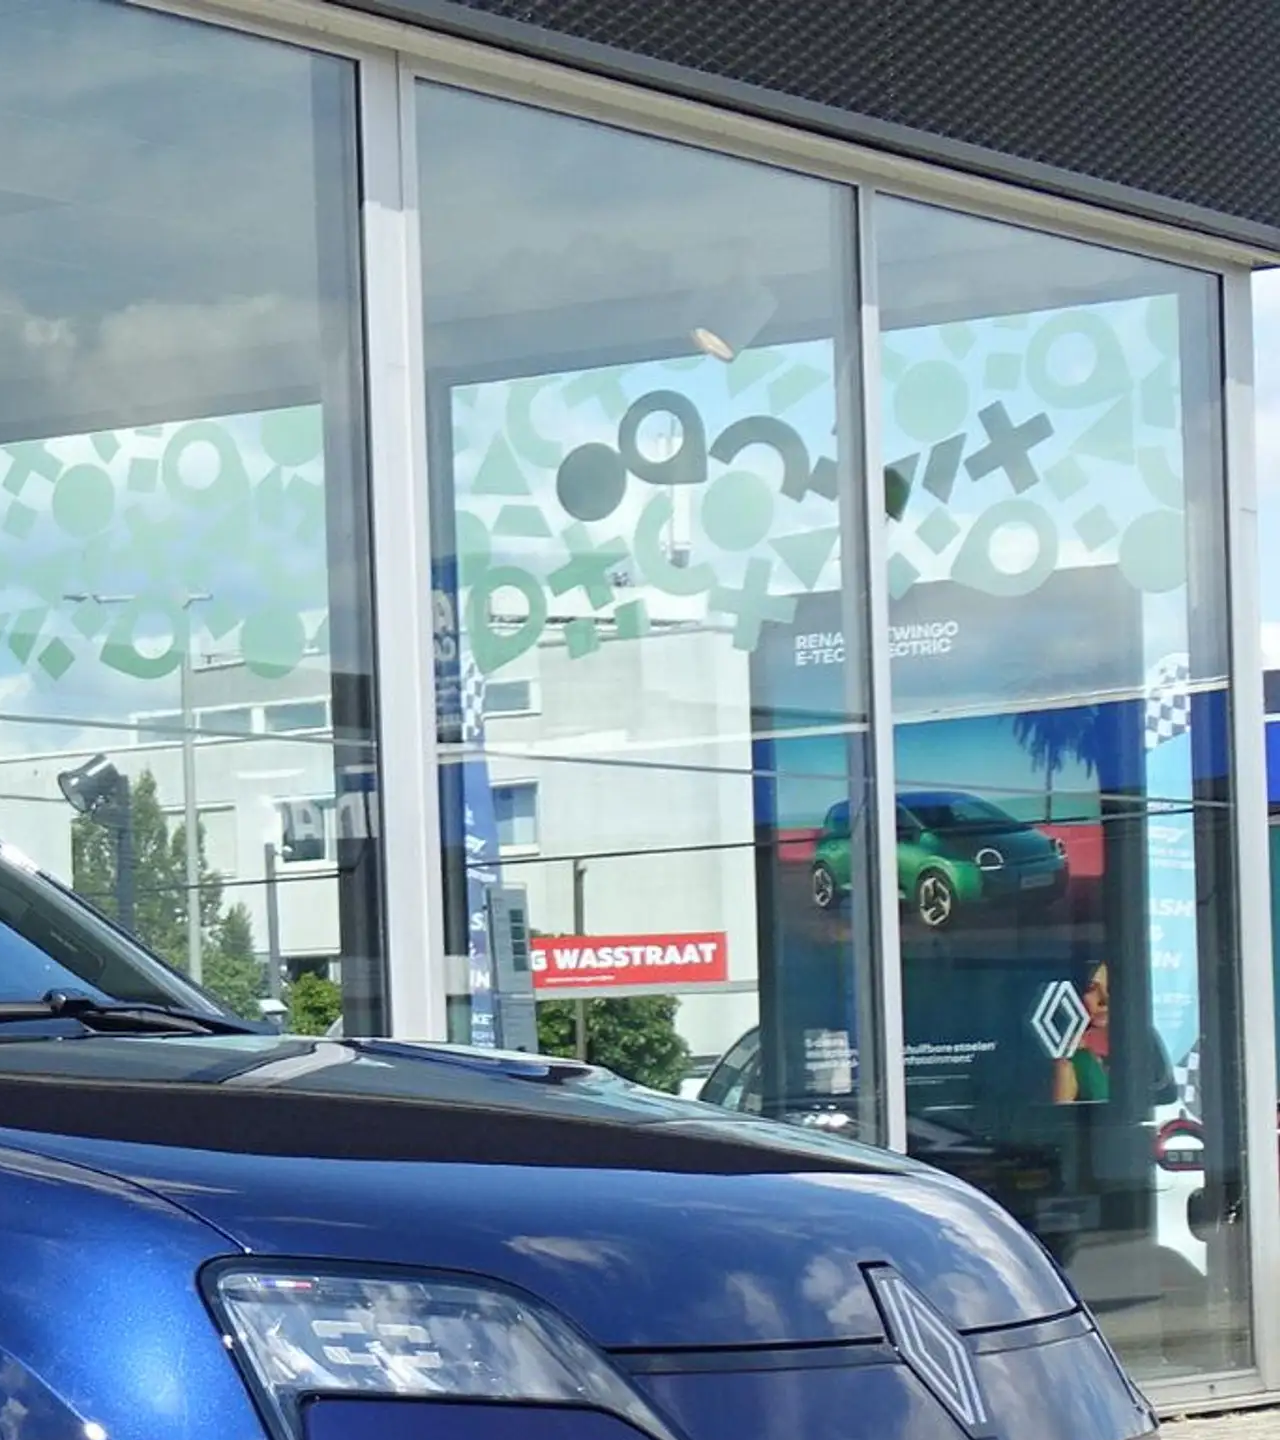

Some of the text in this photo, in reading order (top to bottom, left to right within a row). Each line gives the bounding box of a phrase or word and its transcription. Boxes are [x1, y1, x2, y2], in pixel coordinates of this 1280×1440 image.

[796, 633, 845, 649] RENA
[795, 648, 846, 666] E-TEC
[553, 943, 717, 970] WASSTRAAT
